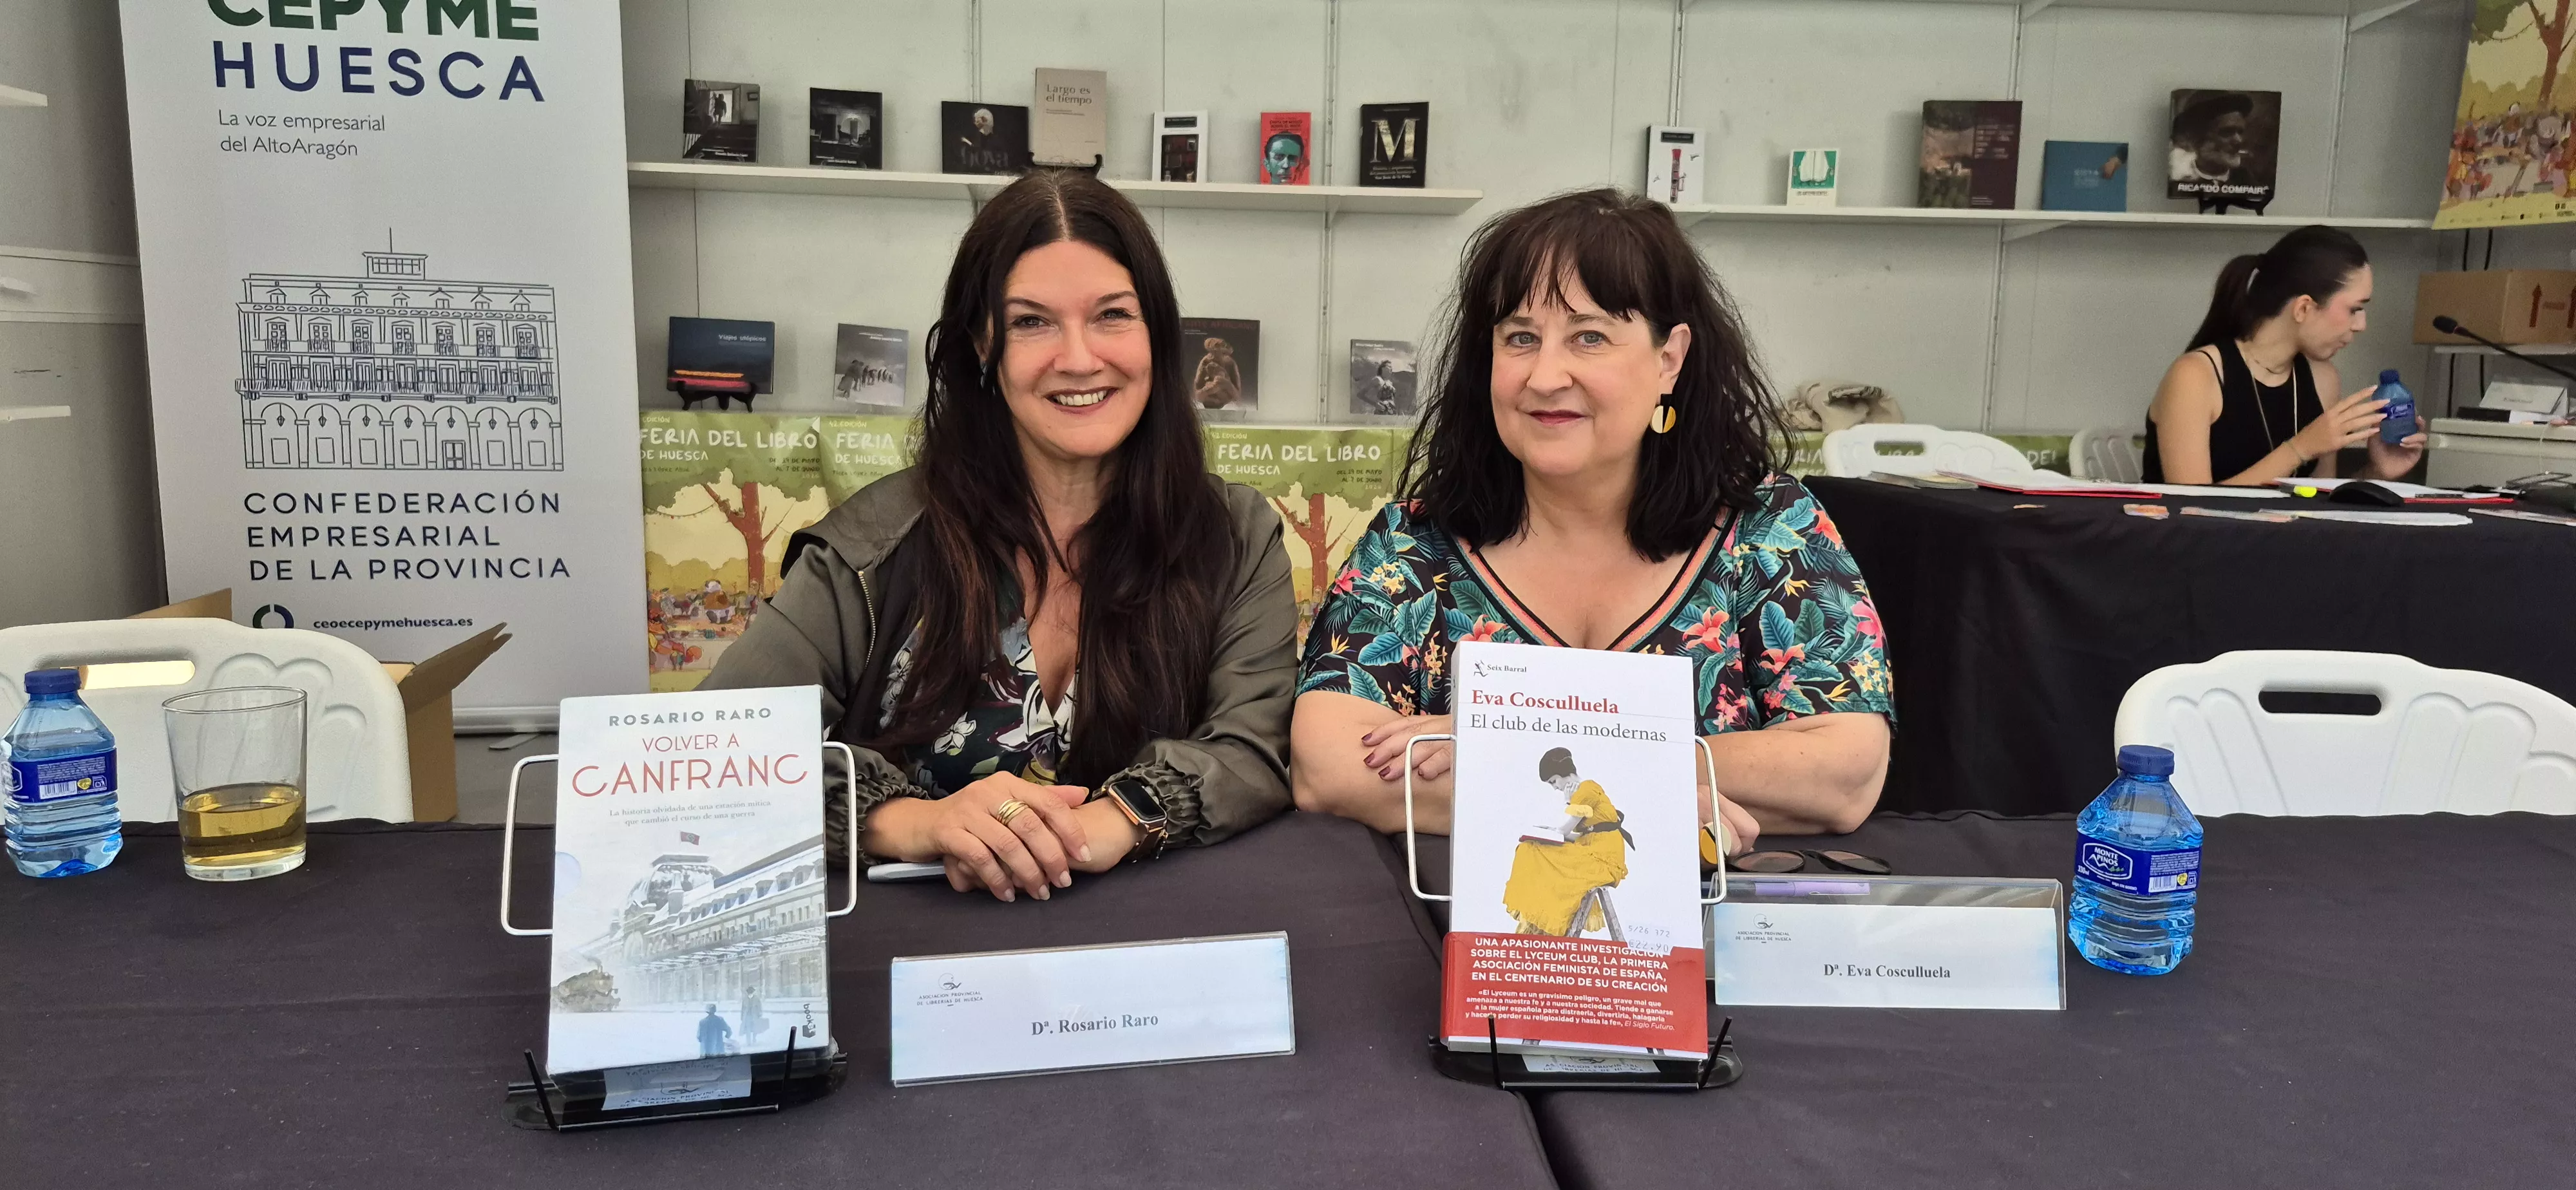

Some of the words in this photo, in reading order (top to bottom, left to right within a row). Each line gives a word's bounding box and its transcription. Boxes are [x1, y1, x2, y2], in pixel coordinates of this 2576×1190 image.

[209, 0, 540, 41] CEPYME
[213, 40, 545, 102] HUESCA
[1046, 84, 1076, 96] Largo
[1046, 93, 1055, 102] el
[1058, 95, 1092, 107] tiempo
[219, 109, 239, 126] La
[245, 114, 277, 128] voz
[283, 114, 385, 133] empresarial
[220, 135, 247, 153] del
[252, 136, 358, 160] AltoAragón
[1369, 117, 1421, 164] M
[840, 420, 867, 428] EDICIÓN
[708, 430, 748, 449] DEL
[757, 431, 819, 449] LIBRO
[837, 432, 895, 449] FERIA
[659, 449, 709, 461] HUESCA
[835, 453, 851, 464] DE
[855, 455, 902, 466] HUESCA
[1218, 443, 1273, 460] FERIA
[1282, 445, 1318, 462] DEL
[1327, 444, 1381, 462] LIBRO
[1217, 464, 1231, 474] DE
[1236, 464, 1280, 475] HUESCA
[244, 489, 561, 515] CONFEDERACIÓN
[247, 525, 500, 547] EMPRESARIAL
[249, 559, 293, 581] DE
[310, 558, 352, 581] LA
[368, 556, 571, 580] PROVINCIA
[313, 616, 473, 631] ceoecepymehuesca.es
[1486, 664, 1502, 672] Seix
[1504, 665, 1527, 674] Barral
[1471, 690, 1504, 706] Eva
[1510, 692, 1619, 714] Cosculluela
[609, 710, 705, 727] ROSARIO
[715, 707, 772, 721] RARO
[1471, 713, 1486, 728] El
[1492, 715, 1527, 732] club
[1531, 717, 1551, 733] de
[1557, 719, 1578, 735] las
[1583, 723, 1667, 742] modernas
[642, 733, 718, 752] VOLVER
[728, 732, 740, 748] A
[572, 753, 808, 797] CANFRANC
[621, 808, 651, 816] historia
[653, 805, 686, 814] olvidada
[715, 801, 746, 809] estación
[625, 818, 639, 827] que
[641, 815, 670, 824] cambió
[730, 811, 755, 820] guerra
[2094, 847, 2118, 861] MONTE
[2097, 854, 2119, 867] PINOS
[1628, 925, 1649, 934] 5/26
[1475, 937, 1499, 947] UNA
[1501, 938, 1578, 952] APASIONANTE
[1470, 948, 1507, 958] SOBRE
[1510, 950, 1522, 959] EL
[1525, 950, 1567, 961] LYCEUM
[1569, 954, 1602, 965] CLUB,
[1604, 956, 1618, 965] LA
[1620, 958, 1669, 970] PRIMERA
[1473, 959, 1540, 971] ASOCIACIÓN
[1543, 963, 1600, 976] FEMINISTA
[1603, 967, 1618, 977] DE
[1620, 968, 1667, 982] ESPAÑA,
[1847, 964, 1871, 978] Eva
[1875, 965, 1951, 979] Cosculluela
[1472, 972, 1486, 981] EN
[1489, 972, 1502, 981] EL
[1504, 973, 1575, 985] CENTENARIO
[1578, 978, 1592, 987] DE
[1595, 978, 1609, 988] SU
[1611, 979, 1668, 993] CREACIÓN
[1491, 990, 1518, 998] Lyceum
[1574, 994, 1601, 1003] peligro,
[1580, 1001, 1613, 1010] sociedad.
[1058, 1015, 1117, 1034] Rosario
[1122, 1013, 1159, 1030] Raro
[1498, 1012, 1522, 1021] perder
[1533, 1014, 1574, 1023] religiosidad
[1633, 1020, 1650, 1028] Siglo
[1651, 1022, 1675, 1031] Futuro.
[1510, 1005, 1542, 1014] española
[1560, 1008, 1595, 1017] distraerla,
[1597, 1010, 1631, 1020] divertirla,
[1633, 1013, 1665, 1023] halagarla
